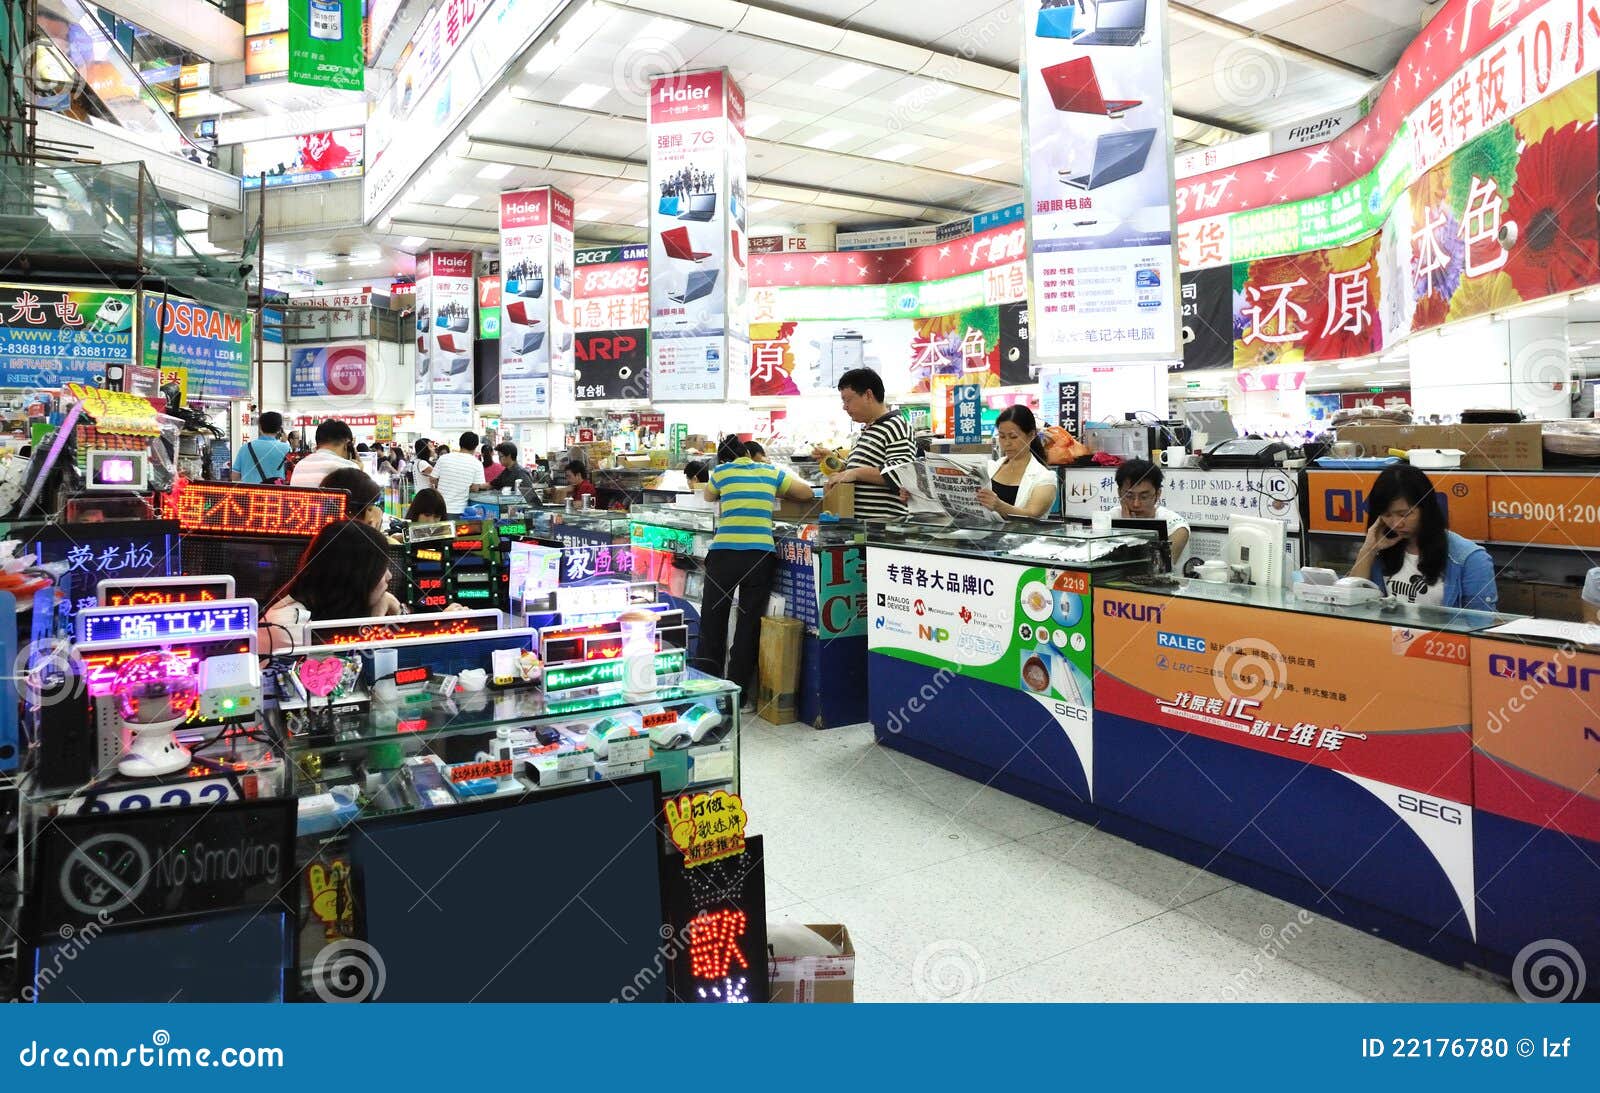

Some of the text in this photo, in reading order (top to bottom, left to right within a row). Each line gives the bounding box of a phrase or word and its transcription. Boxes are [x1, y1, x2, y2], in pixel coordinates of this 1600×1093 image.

[660, 85, 711, 104] Haier
[692, 131, 715, 145] 7G
[1289, 117, 1343, 141] FinePix
[506, 202, 541, 215] Haier
[1037, 197, 1093, 213] 润眼电脑
[1413, 176, 1512, 298] 本色
[437, 256, 468, 267] Haier
[576, 250, 612, 264] acer
[0, 291, 84, 328] 光电
[291, 297, 329, 307] SanDisk
[1241, 262, 1373, 346] 还原
[155, 302, 243, 344] OSRAM
[1084, 327, 1155, 343] 笔记本电脑
[73, 346, 128, 359] 83681792
[750, 338, 789, 384] 原
[911, 326, 991, 383] 本色
[575, 385, 606, 398] 复合机
[1061, 385, 1077, 440] 空中充
[1071, 483, 1093, 498] KH
[1190, 478, 1206, 491] DIP
[1270, 480, 1286, 493] IC
[887, 563, 996, 597] 专营各大品牌IC
[1063, 577, 1085, 592] 2219
[887, 595, 910, 605] ANALOG
[887, 602, 910, 613] DEVICES
[919, 624, 949, 643] NXP
[1159, 633, 1206, 653] RALEC
[1425, 639, 1468, 661] 2220
[1055, 703, 1088, 722] SEG
[1249, 719, 1358, 753] 就上维库
[1398, 794, 1462, 825] SEG
[155, 841, 281, 887] No Smoking
